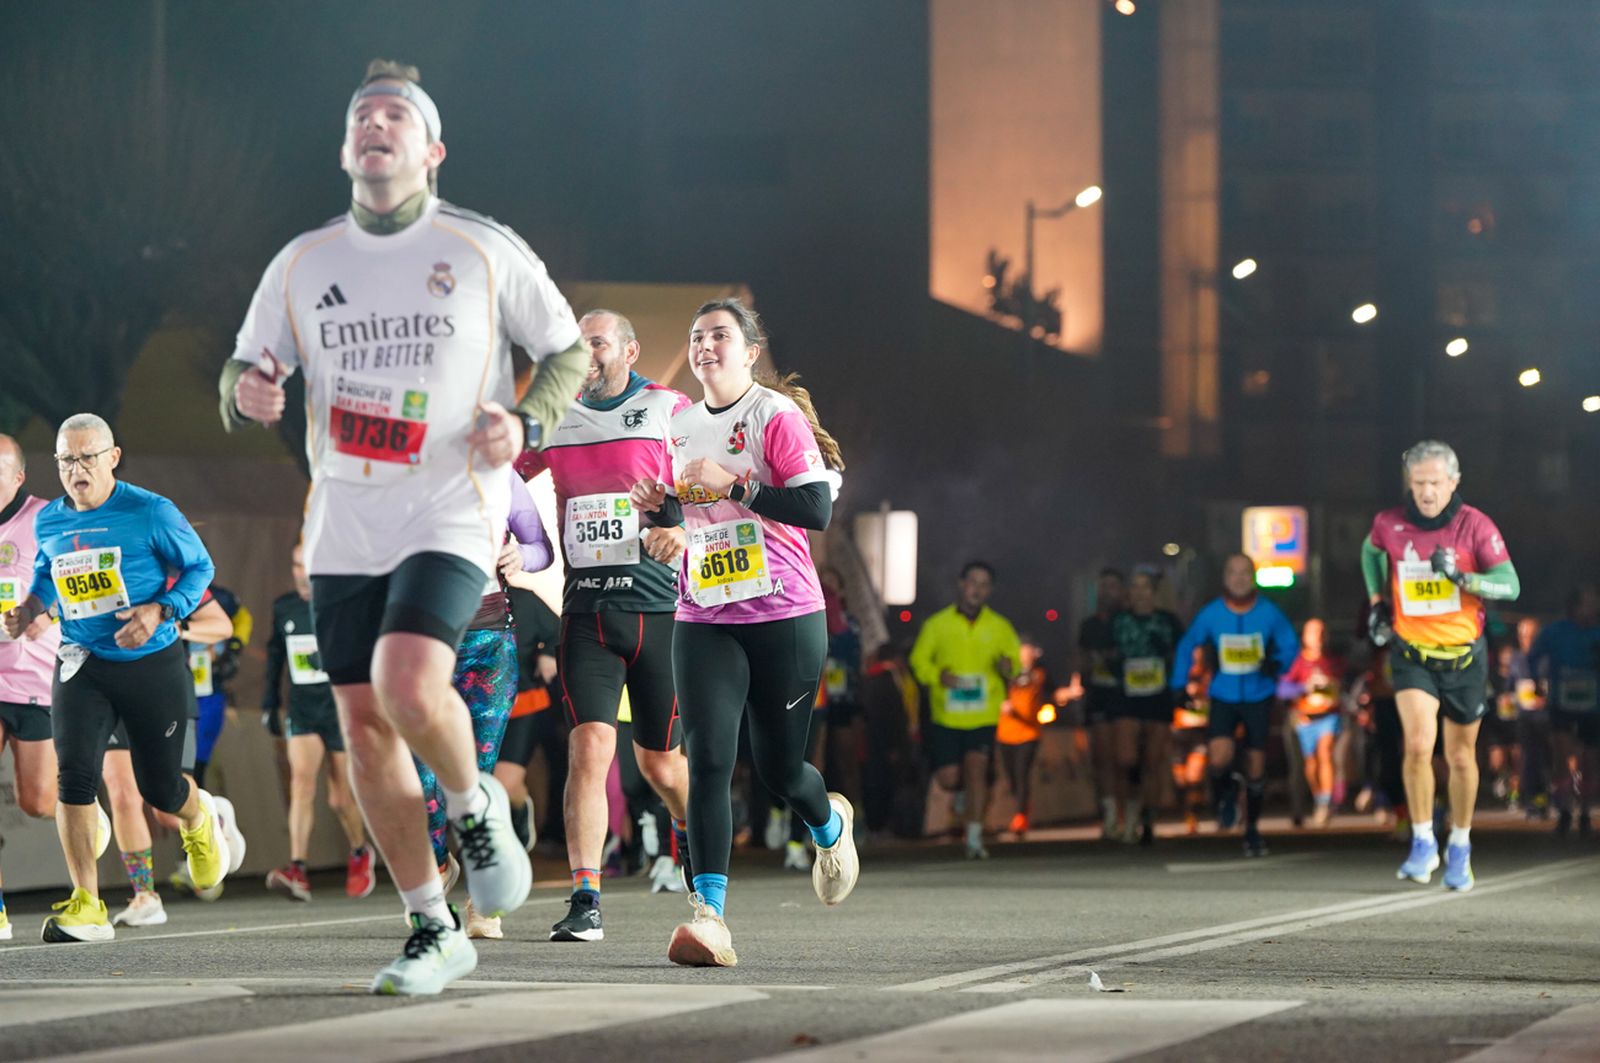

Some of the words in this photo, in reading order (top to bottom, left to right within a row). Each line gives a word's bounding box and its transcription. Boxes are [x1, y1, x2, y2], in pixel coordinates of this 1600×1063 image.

[319, 312, 455, 349] Emirates
[341, 347, 369, 371] FLY
[374, 342, 435, 369] BETTER
[340, 411, 409, 452] 9736
[575, 519, 624, 543] 3543
[700, 548, 750, 580] 6618
[65, 571, 113, 596] 9546
[1415, 581, 1442, 596] 941
